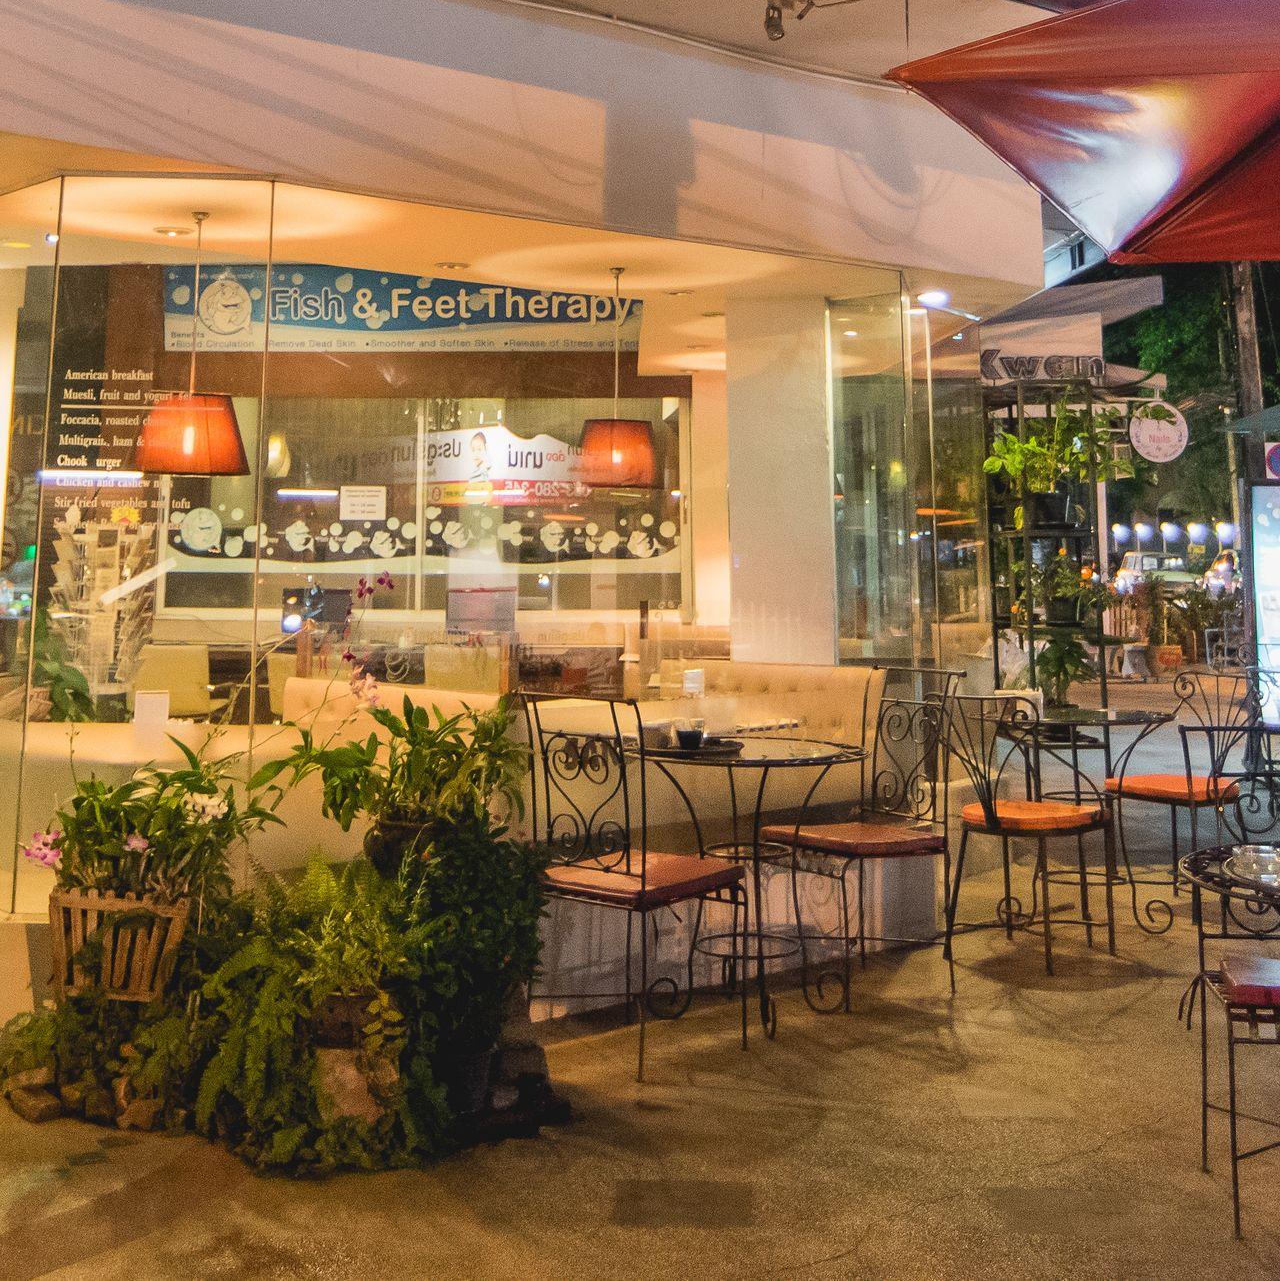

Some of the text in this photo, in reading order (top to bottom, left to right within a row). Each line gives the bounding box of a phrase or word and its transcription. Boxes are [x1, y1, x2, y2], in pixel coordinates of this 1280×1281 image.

[270, 287, 631, 327] Fish & Feet Therapy
[269, 340, 306, 348] Remove
[370, 339, 417, 348] Smoother
[419, 339, 436, 348] and
[65, 369, 154, 381] American breakfast
[63, 389, 97, 402] Muesli,
[100, 389, 121, 401] fruit
[123, 390, 142, 401] and
[144, 391, 173, 404] yogurt
[106, 414, 139, 426] roasted
[113, 435, 133, 447] ham
[57, 454, 88, 467] Chook
[56, 476, 174, 488] Chicken and cashew ns
[55, 496, 71, 508] Stir
[74, 496, 97, 508] fried
[101, 497, 147, 510] vegetables
[172, 497, 191, 509] tofu
